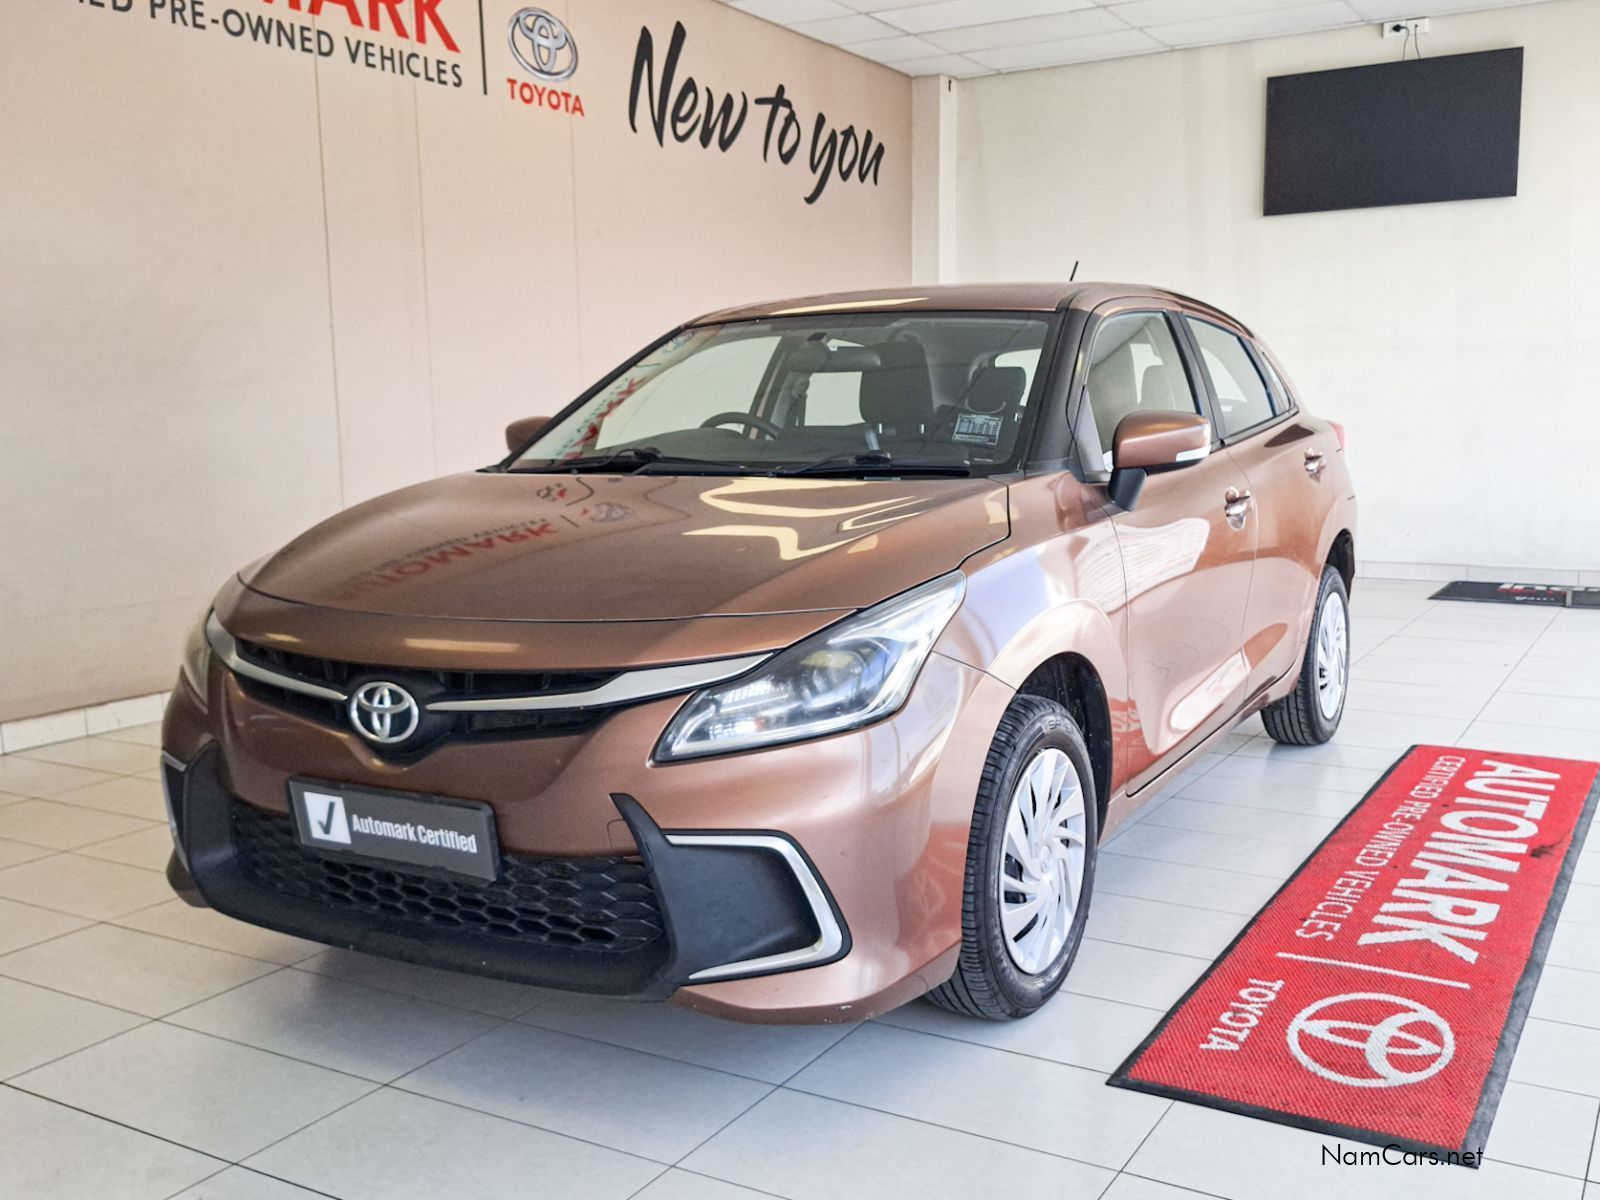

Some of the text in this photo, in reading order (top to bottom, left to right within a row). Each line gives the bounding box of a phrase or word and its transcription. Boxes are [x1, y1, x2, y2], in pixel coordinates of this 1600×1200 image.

[149, 0, 463, 88] PRE-OWNED VEHICLES
[261, 0, 462, 54] RK
[506, 77, 585, 117] TOYOTA
[628, 20, 885, 205] New to you
[352, 814, 478, 853] Automark Certified
[1295, 755, 1466, 941] CERTIFIED PRE-OWNED VEHICLES
[1357, 758, 1561, 964] AUTOMARK
[1199, 977, 1285, 1052] TOYOTA
